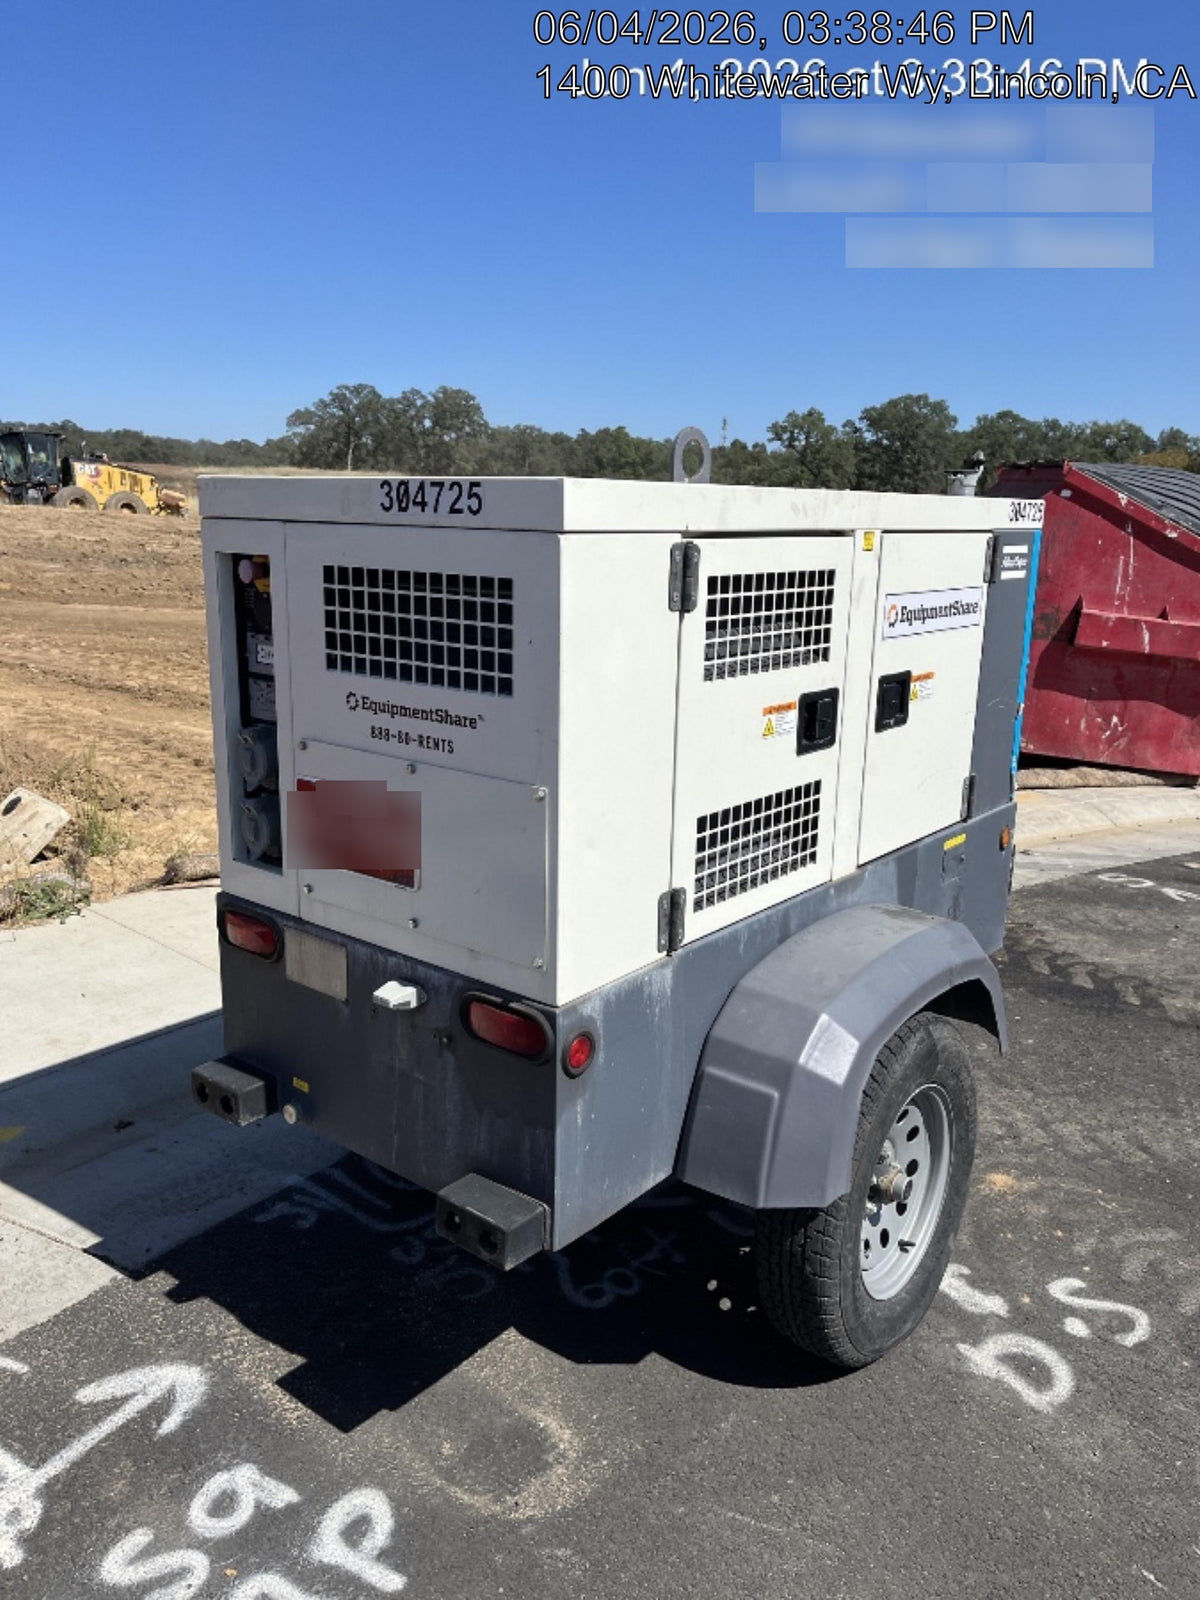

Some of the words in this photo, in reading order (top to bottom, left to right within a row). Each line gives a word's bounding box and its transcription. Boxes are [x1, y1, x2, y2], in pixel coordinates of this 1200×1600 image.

[380, 479, 483, 516] 304725
[899, 602, 979, 626] EquipmentShare
[361, 696, 478, 730] EquipmentShare
